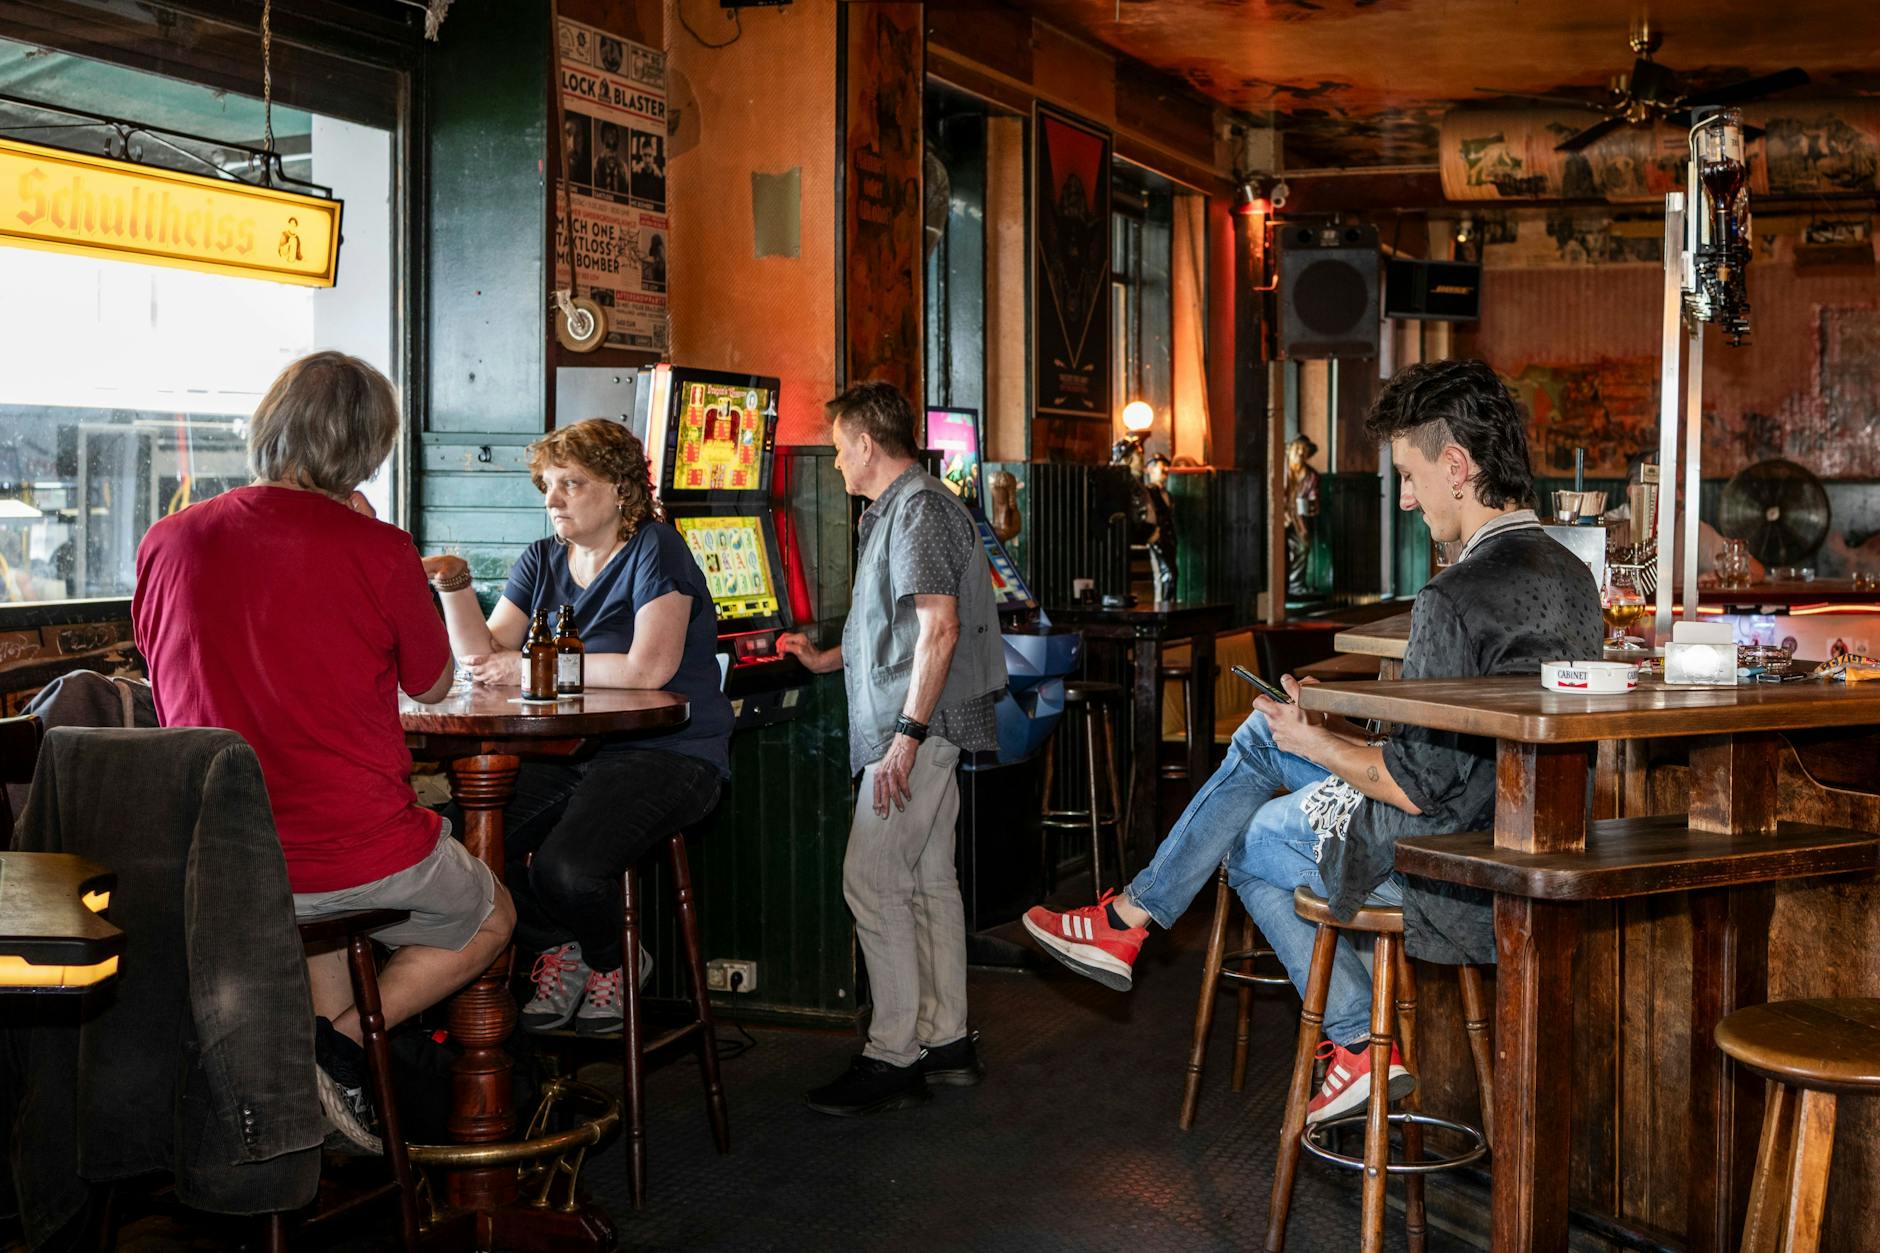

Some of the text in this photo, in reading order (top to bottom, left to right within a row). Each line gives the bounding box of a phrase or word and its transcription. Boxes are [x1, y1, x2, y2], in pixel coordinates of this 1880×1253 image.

[562, 71, 665, 118] LOCK BLASTER
[16, 167, 256, 254] Schultheiss
[556, 215, 587, 235] MCH
[592, 222, 614, 240] ONE
[576, 252, 619, 275] BOMBER
[1557, 670, 1588, 680] CABINET
